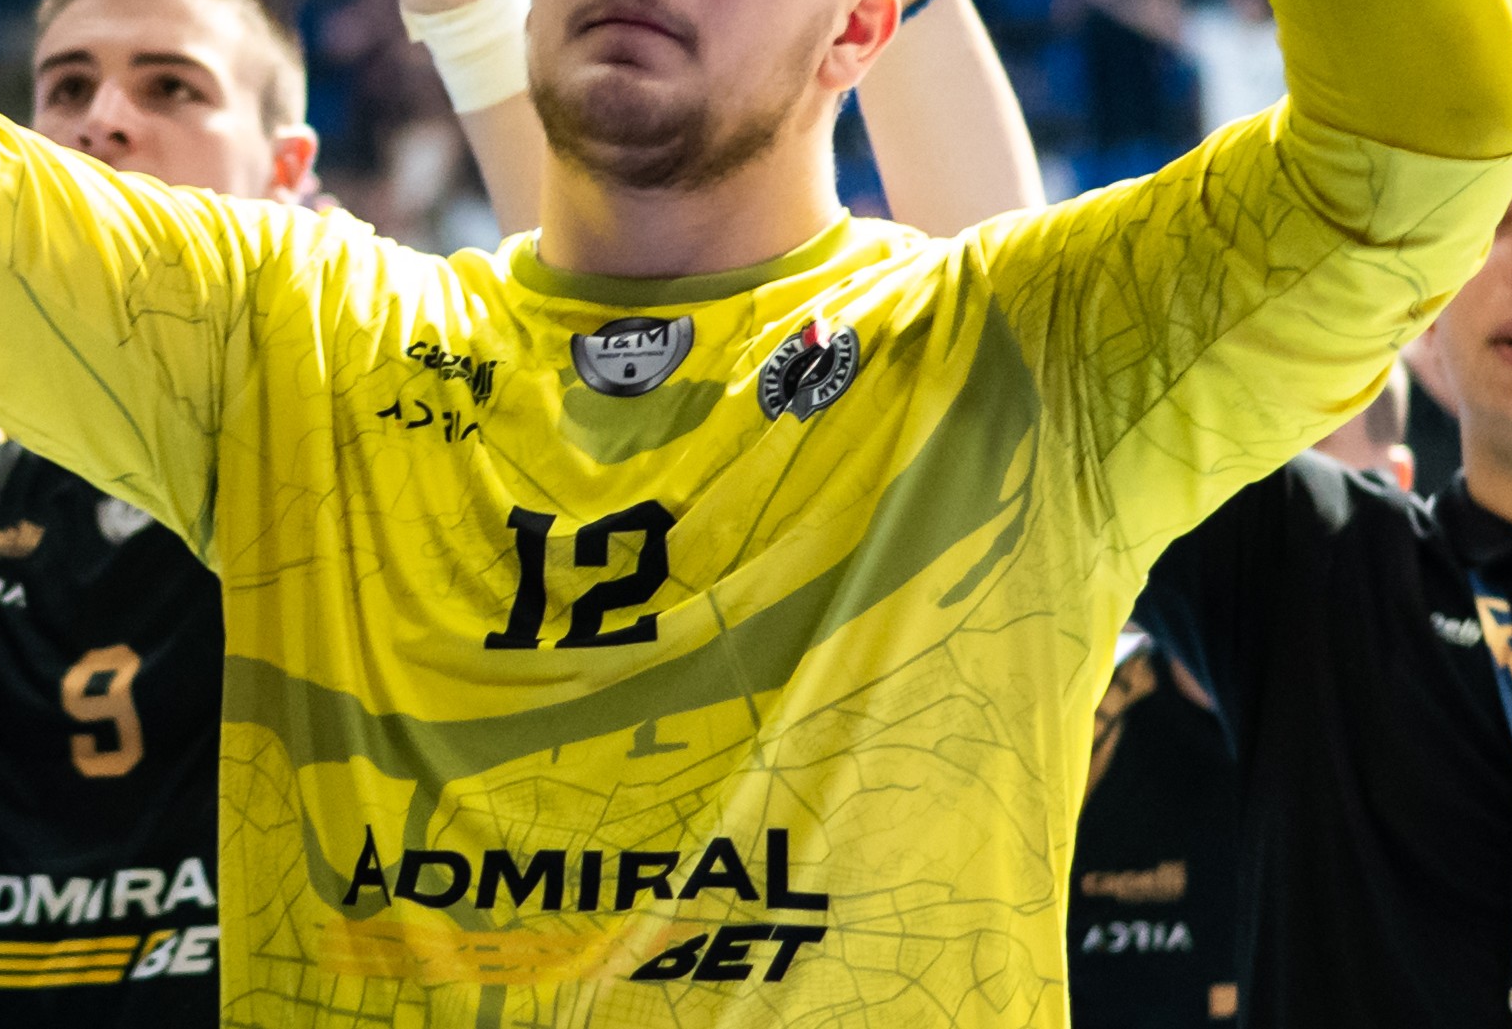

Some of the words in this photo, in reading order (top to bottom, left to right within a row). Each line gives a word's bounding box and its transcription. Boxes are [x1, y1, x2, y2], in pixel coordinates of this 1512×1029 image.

[484, 500, 677, 649] 12
[62, 644, 145, 777] 9
[342, 825, 829, 911] ADMIRAL
[130, 925, 220, 981] BE
[629, 925, 829, 982] BET
